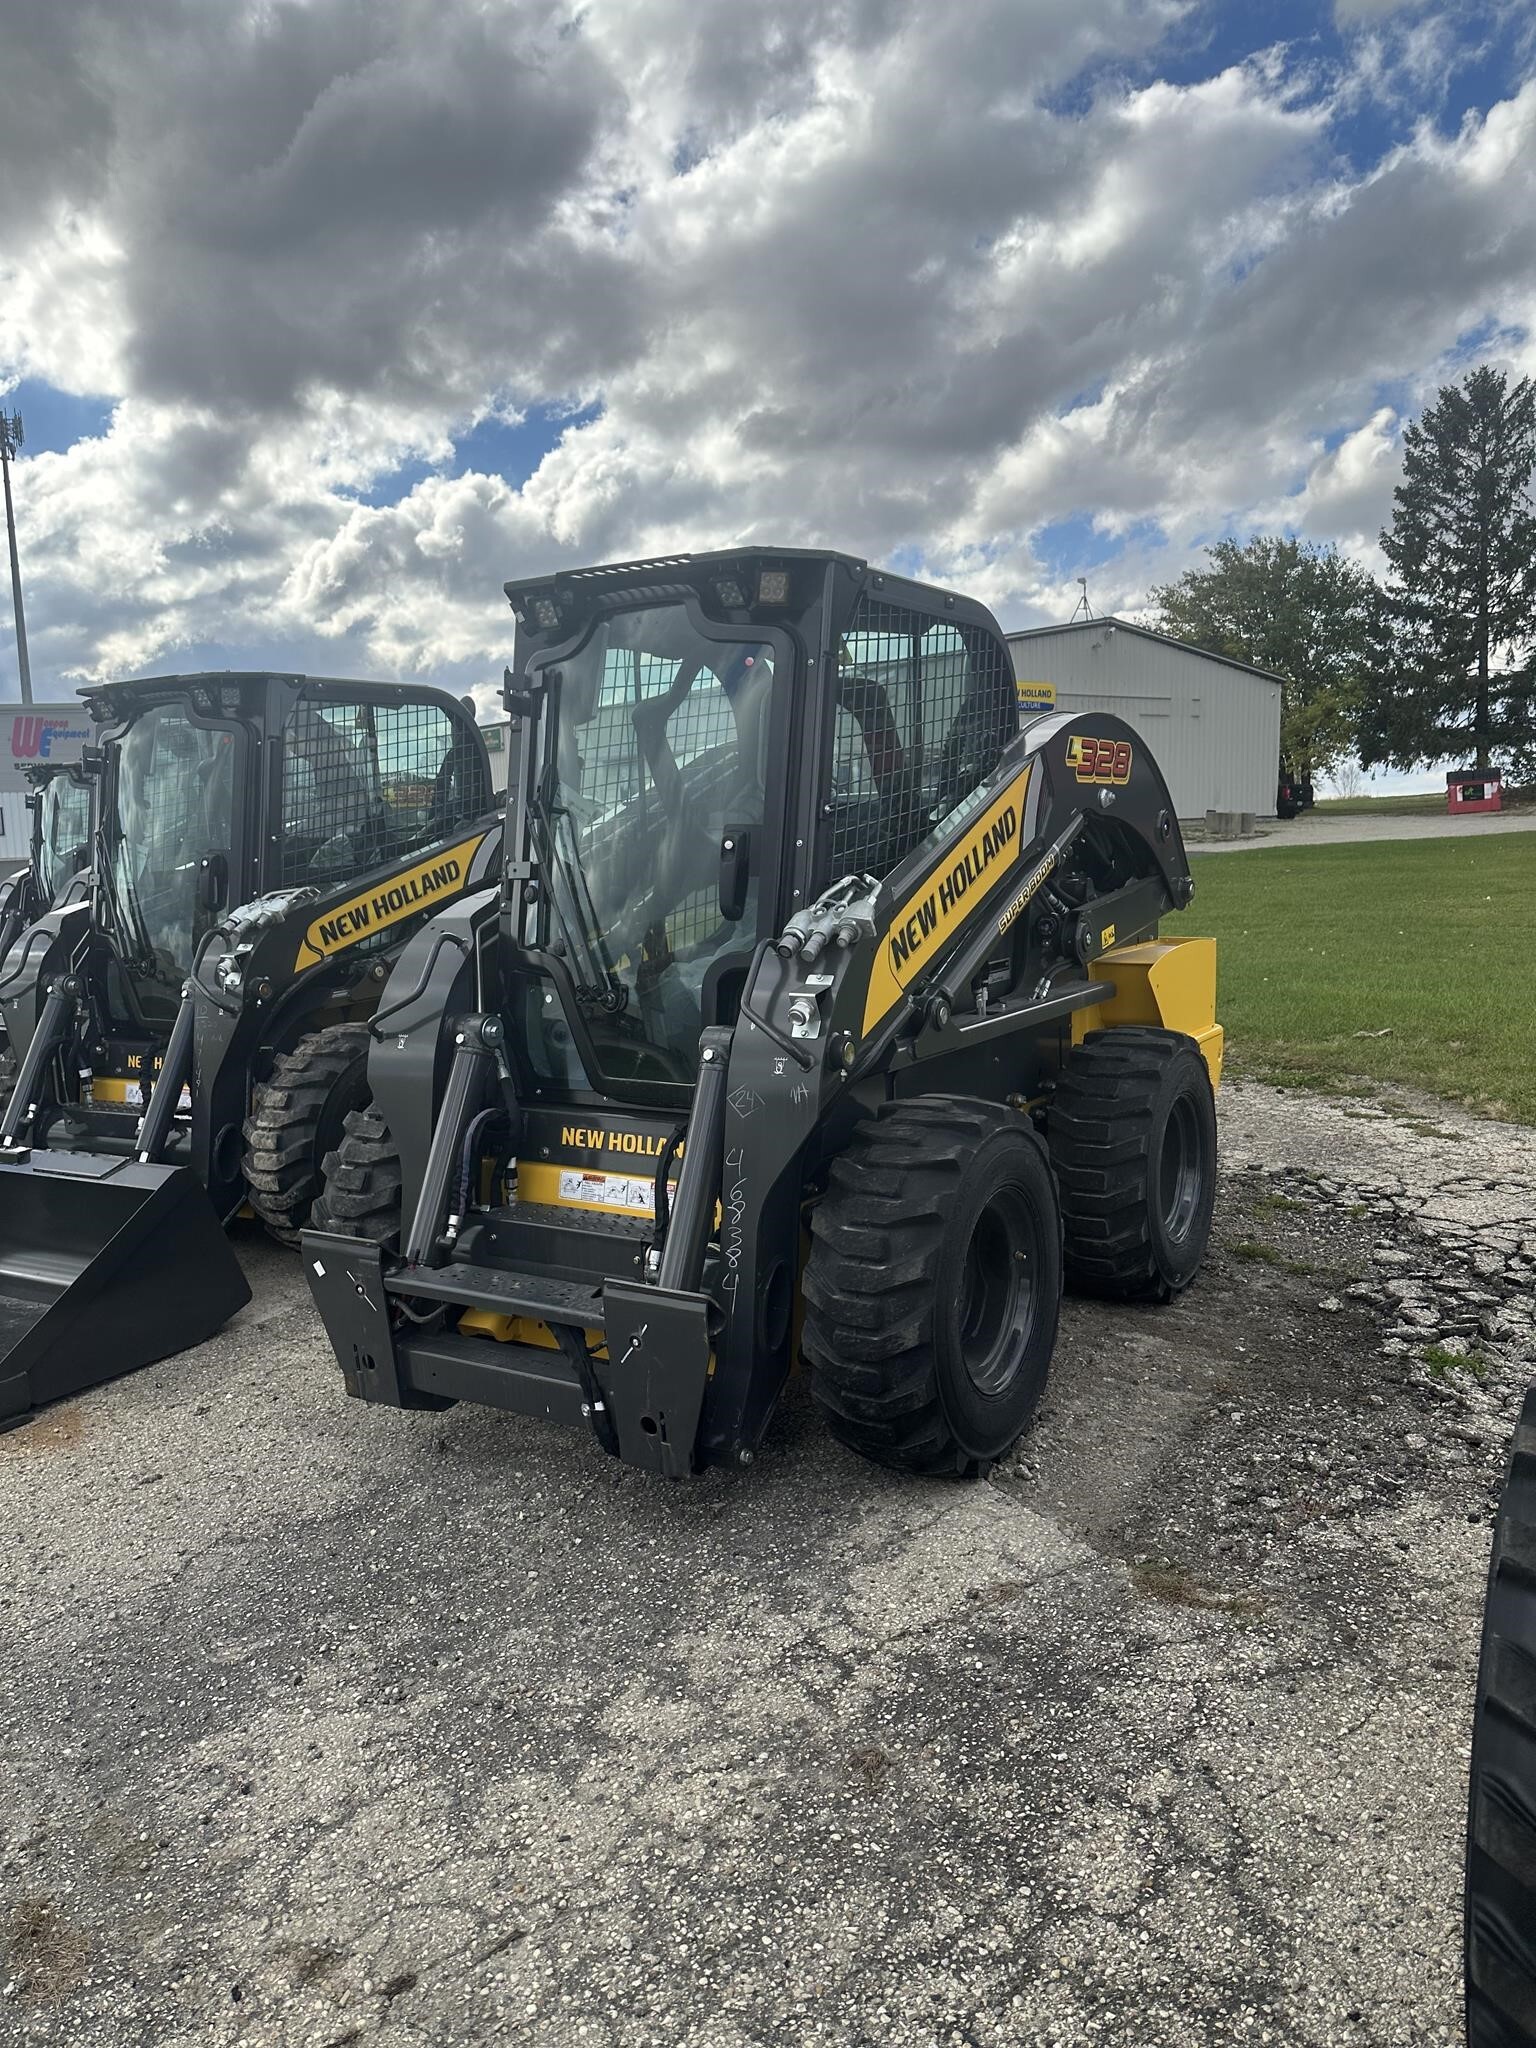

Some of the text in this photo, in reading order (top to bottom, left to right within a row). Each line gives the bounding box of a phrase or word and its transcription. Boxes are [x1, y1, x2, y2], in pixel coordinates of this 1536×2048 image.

[1021, 688, 1052, 699] HOLLAND
[1066, 736, 1132, 784] L328
[319, 859, 460, 946] NEW HOLLAND
[890, 805, 1017, 972] NEW HOLLAND
[998, 853, 1055, 935] SUPER BOOM
[127, 1055, 142, 1068] NE
[561, 1126, 686, 1159] NEW HOLLAN
